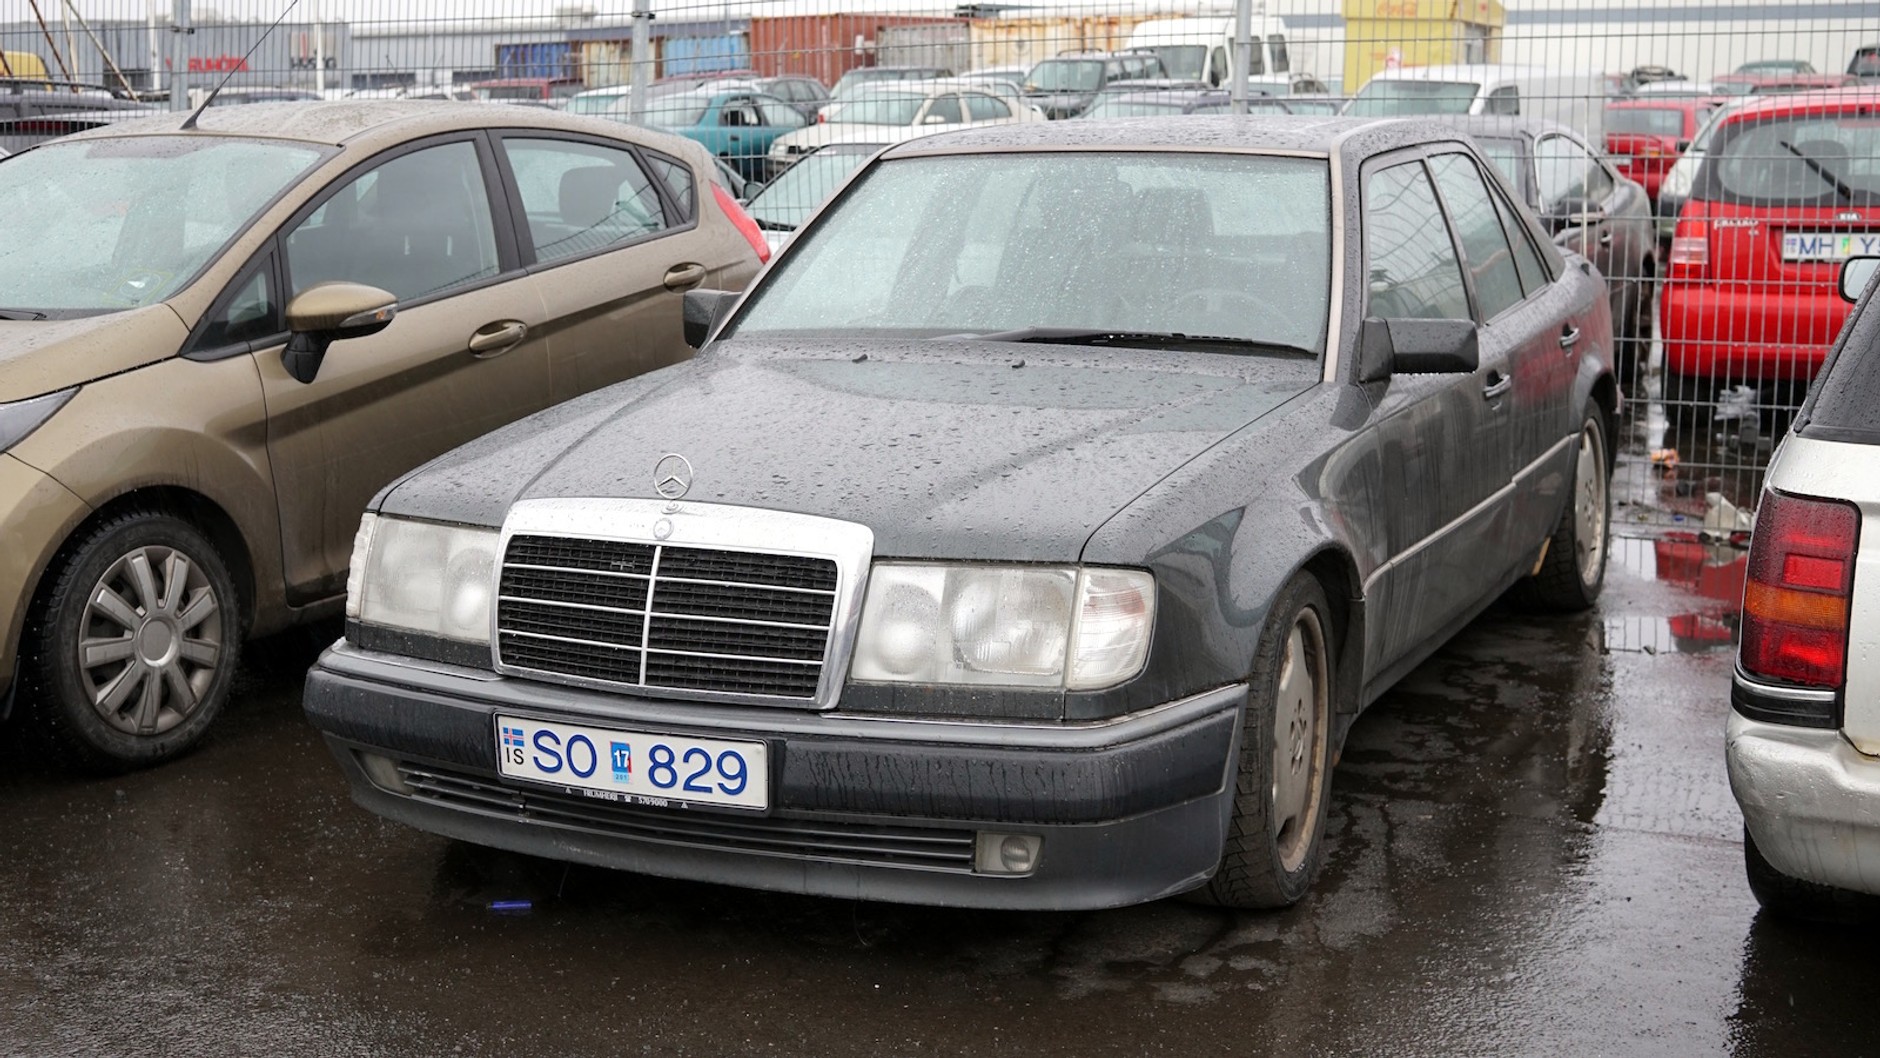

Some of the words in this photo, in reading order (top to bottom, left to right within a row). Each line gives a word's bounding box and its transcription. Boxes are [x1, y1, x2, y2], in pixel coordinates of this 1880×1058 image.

[1840, 212, 1858, 221] KIA
[1800, 237, 1834, 255] MH
[1860, 237, 1880, 254] Y
[506, 747, 525, 765] IS
[532, 729, 598, 779] SO
[648, 743, 748, 796] 829
[614, 749, 630, 768] 17
